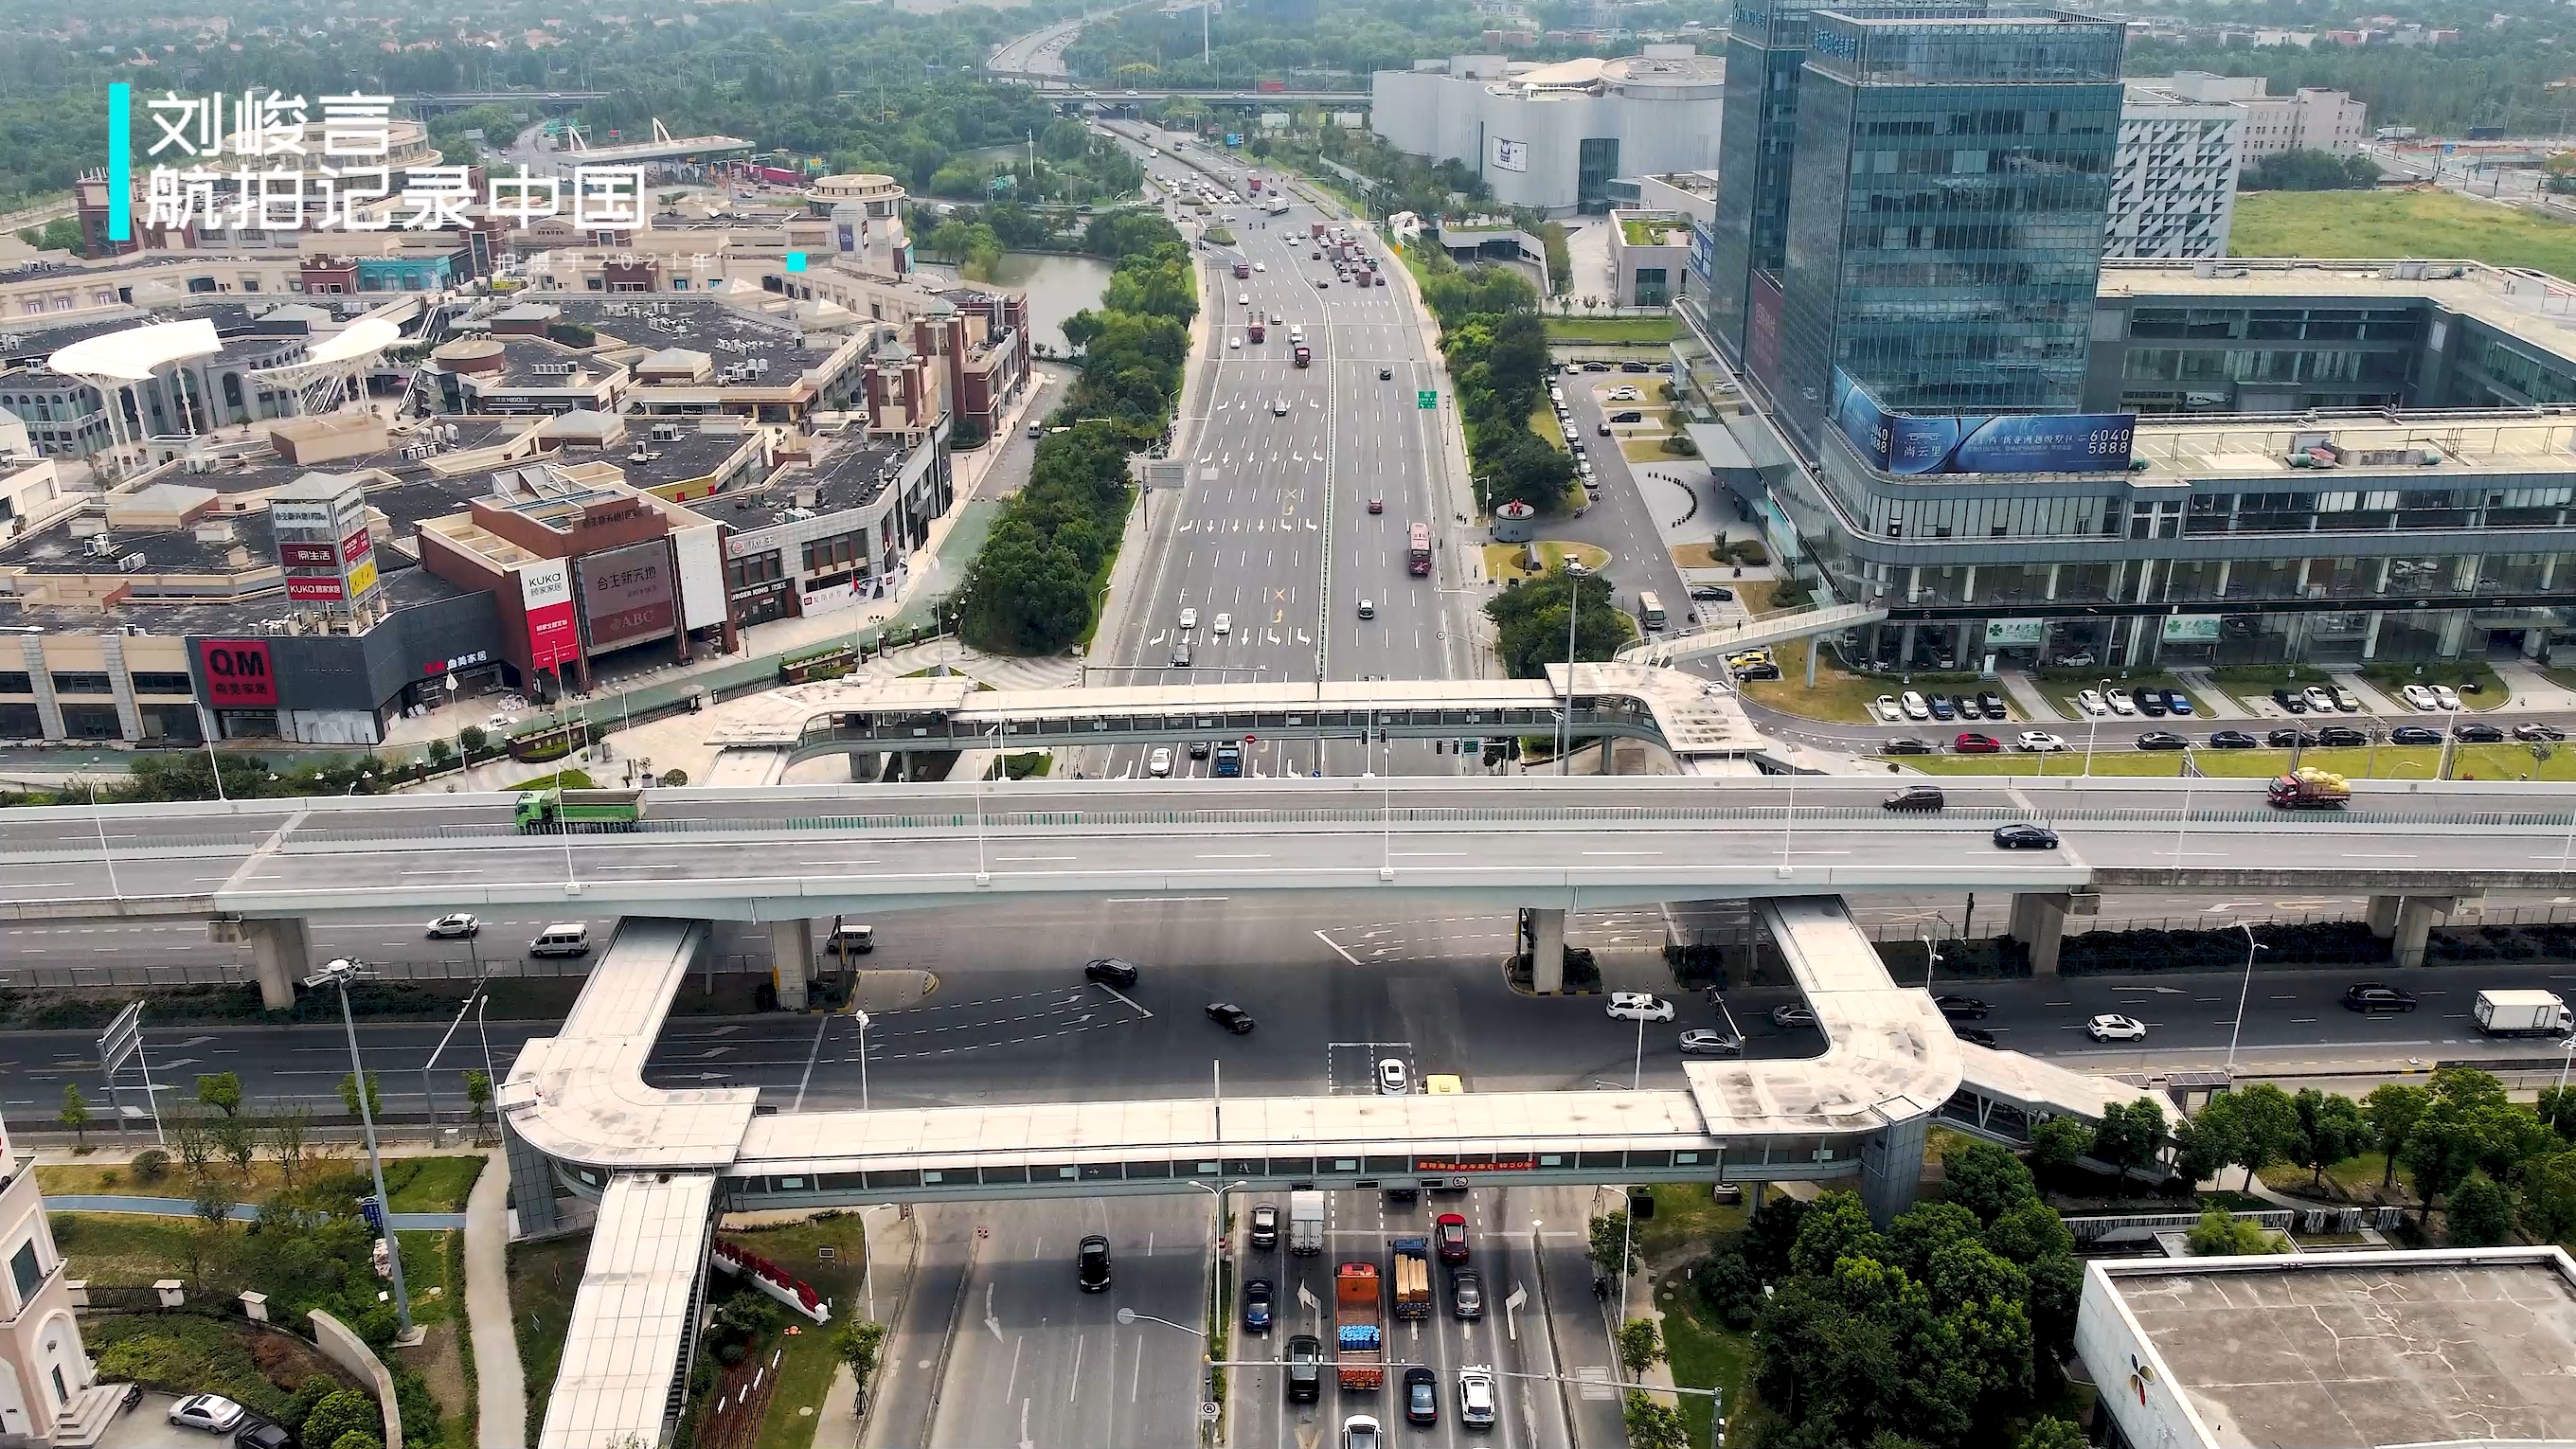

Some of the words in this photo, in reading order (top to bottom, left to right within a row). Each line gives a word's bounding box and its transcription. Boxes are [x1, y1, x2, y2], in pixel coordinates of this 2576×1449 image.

[2089, 429, 2129, 441] 6040
[2087, 441, 2128, 455] 5888
[622, 610, 655, 629] ABC
[210, 649, 264, 677] QM
